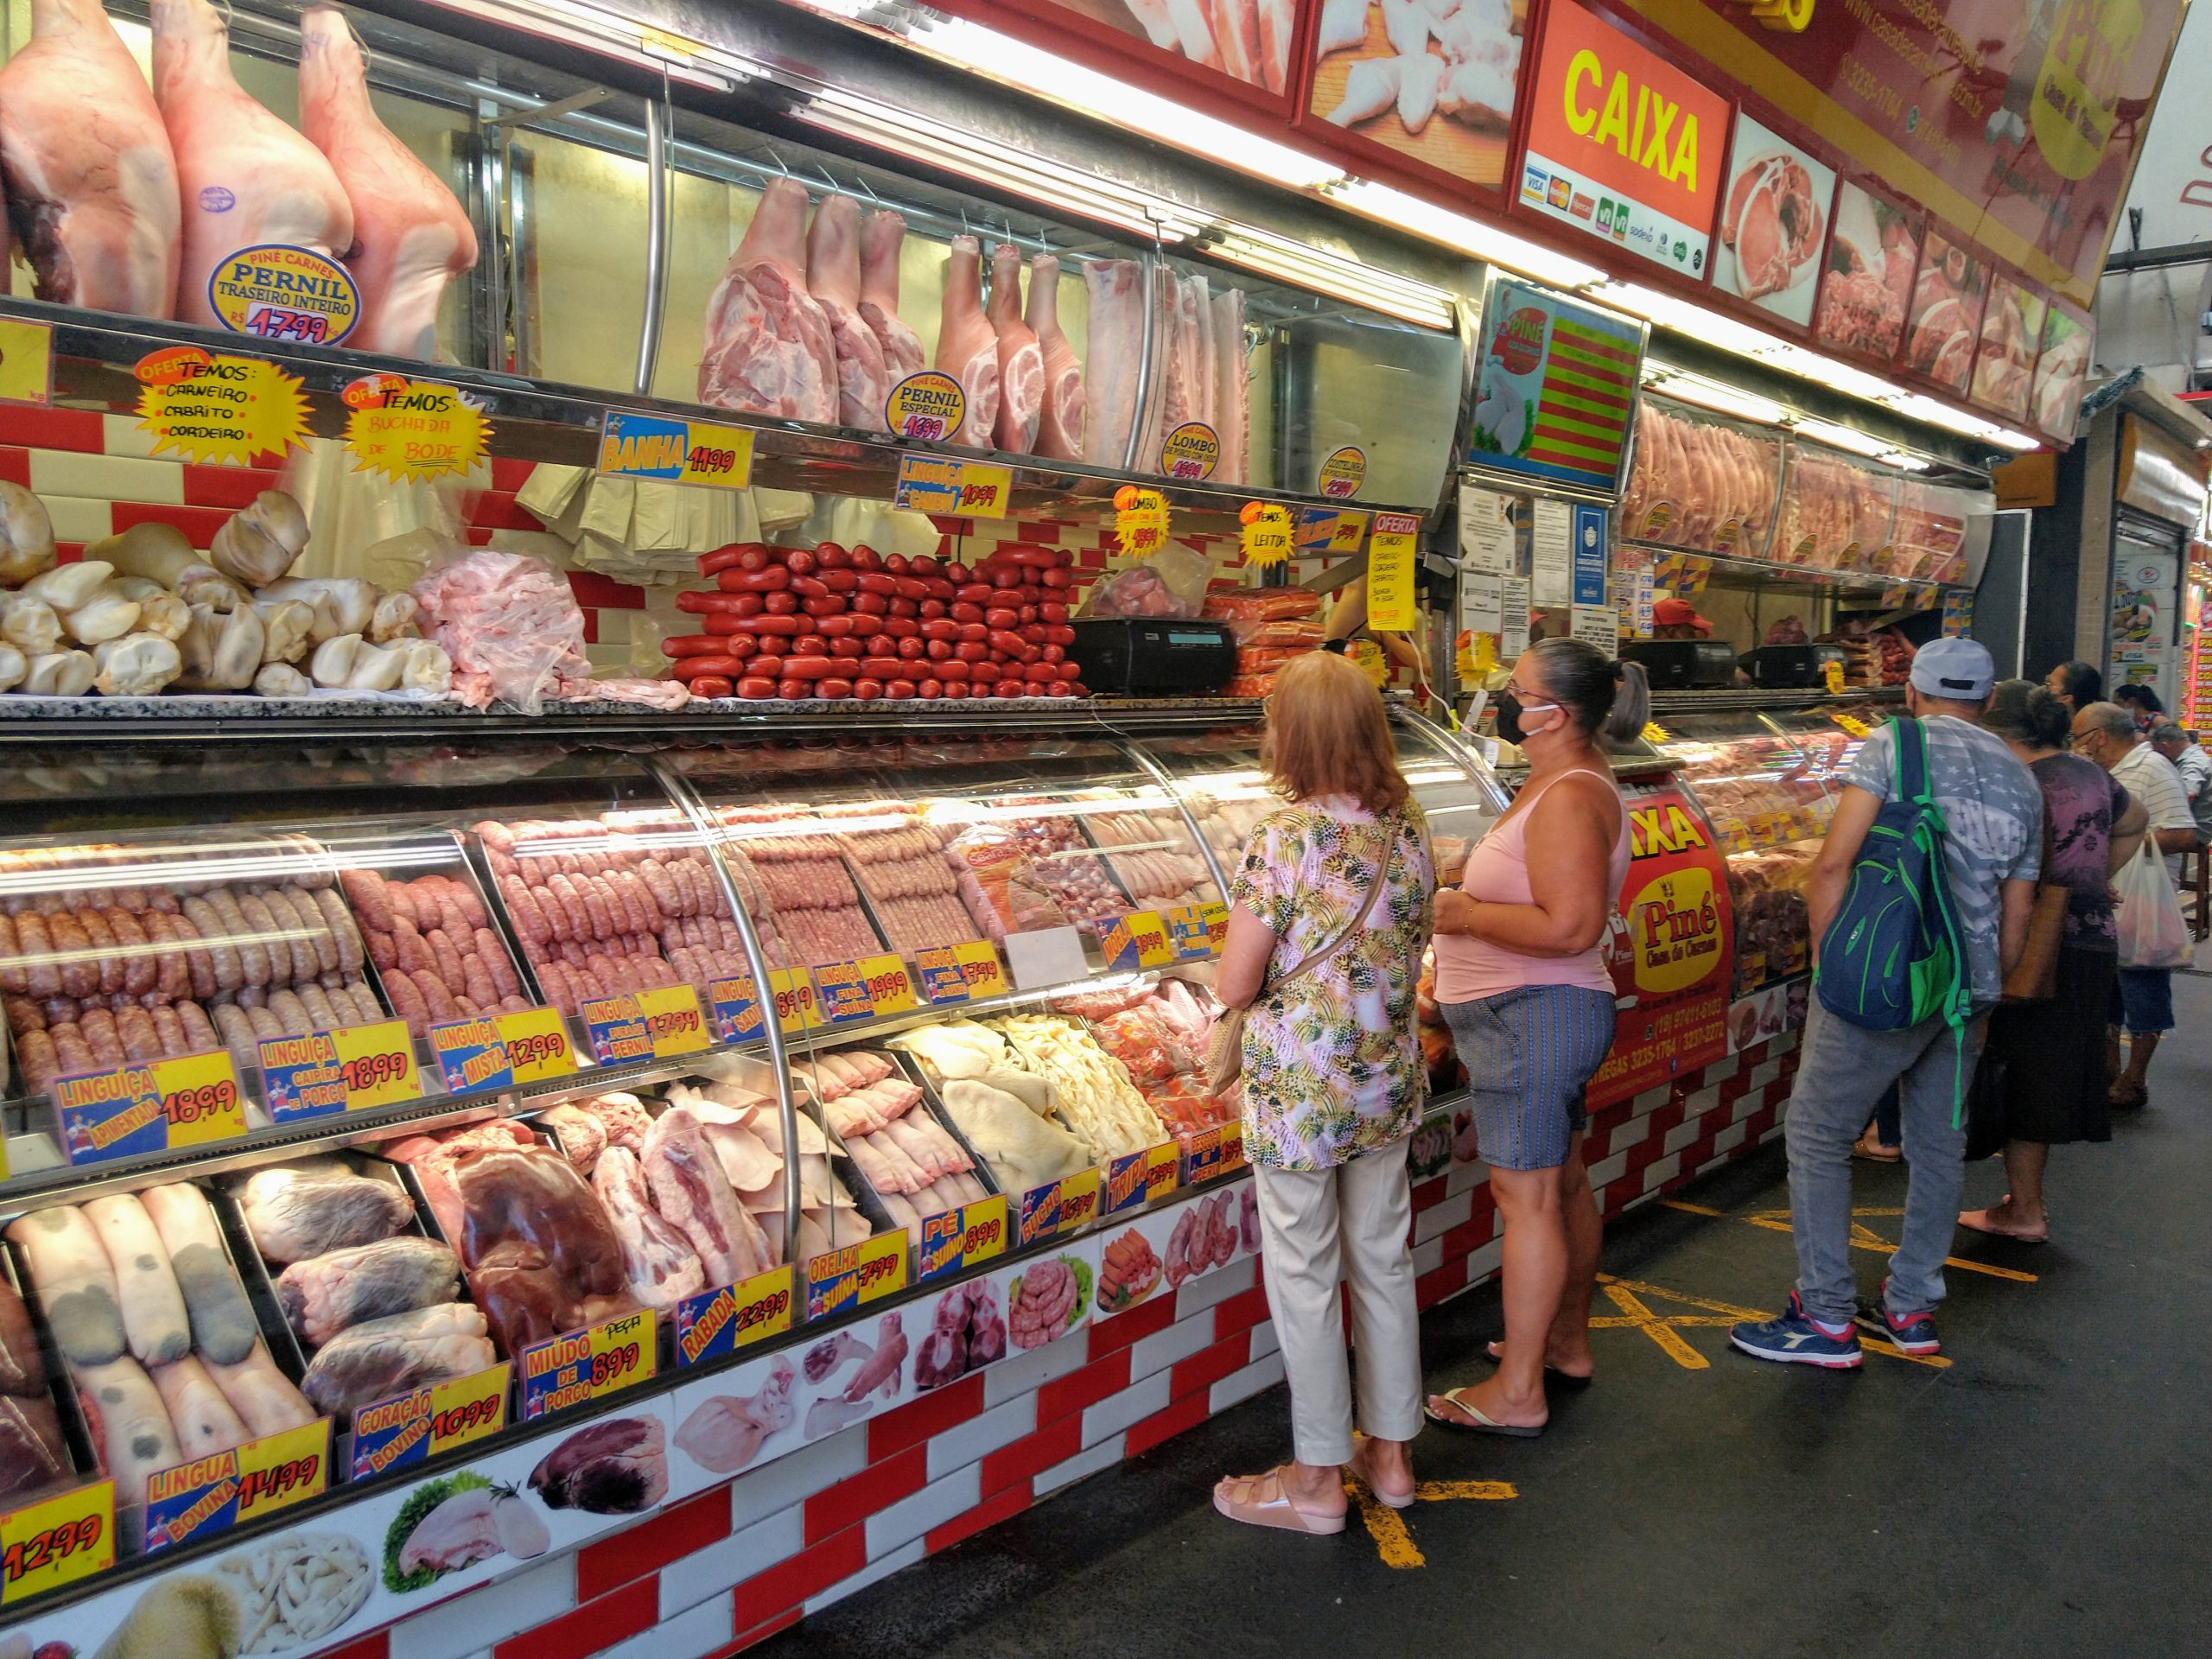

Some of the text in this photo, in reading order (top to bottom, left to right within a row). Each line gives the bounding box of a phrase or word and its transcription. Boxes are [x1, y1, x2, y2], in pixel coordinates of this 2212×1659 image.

[1564, 48, 1697, 194] CAIXA
[1528, 175, 1543, 192] VISA
[250, 250, 334, 279] PINÉ CARNES
[219, 282, 351, 315] TRASEIRO INTEIRO
[232, 263, 347, 301] PERNIL
[140, 353, 204, 379] OFERTA
[899, 387, 961, 408] PERNIL
[899, 402, 956, 417] ESPECIAL
[367, 416, 451, 434] BUCHADA
[368, 442, 461, 460] DE BODE
[601, 435, 684, 472] BANHA
[1173, 435, 1217, 454] LOMBO
[1376, 516, 1417, 533] OFERTA
[1640, 890, 1717, 949] Piné
[710, 975, 757, 1003] LINGUÍÇ
[935, 970, 961, 983] FINA
[836, 987, 866, 1001] FINA
[838, 998, 874, 1016] SUÍNA
[609, 1037, 654, 1059] PERNIL
[293, 1066, 340, 1086] CAIPIRA
[462, 1046, 510, 1086] MISTA
[300, 1083, 346, 1108] PORCO
[89, 1098, 162, 1150] APIMENTADA
[1110, 1153, 1147, 1211] TRIPA
[925, 1209, 958, 1243] PÉ
[1022, 1185, 1061, 1244] BUCHO
[810, 1245, 858, 1284] ORELHA
[823, 1272, 859, 1314] SUÍNA
[606, 1315, 640, 1339] PEÇA
[681, 1288, 737, 1363] RABADA
[527, 1336, 591, 1378] MIÚDO
[557, 1366, 578, 1388] DE
[358, 1389, 432, 1436] CORAÇÃO
[544, 1379, 591, 1414] PORCO
[369, 1416, 431, 1472] BOVINO
[149, 1450, 237, 1504] LINGUA
[166, 1479, 238, 1542] BOVINA
